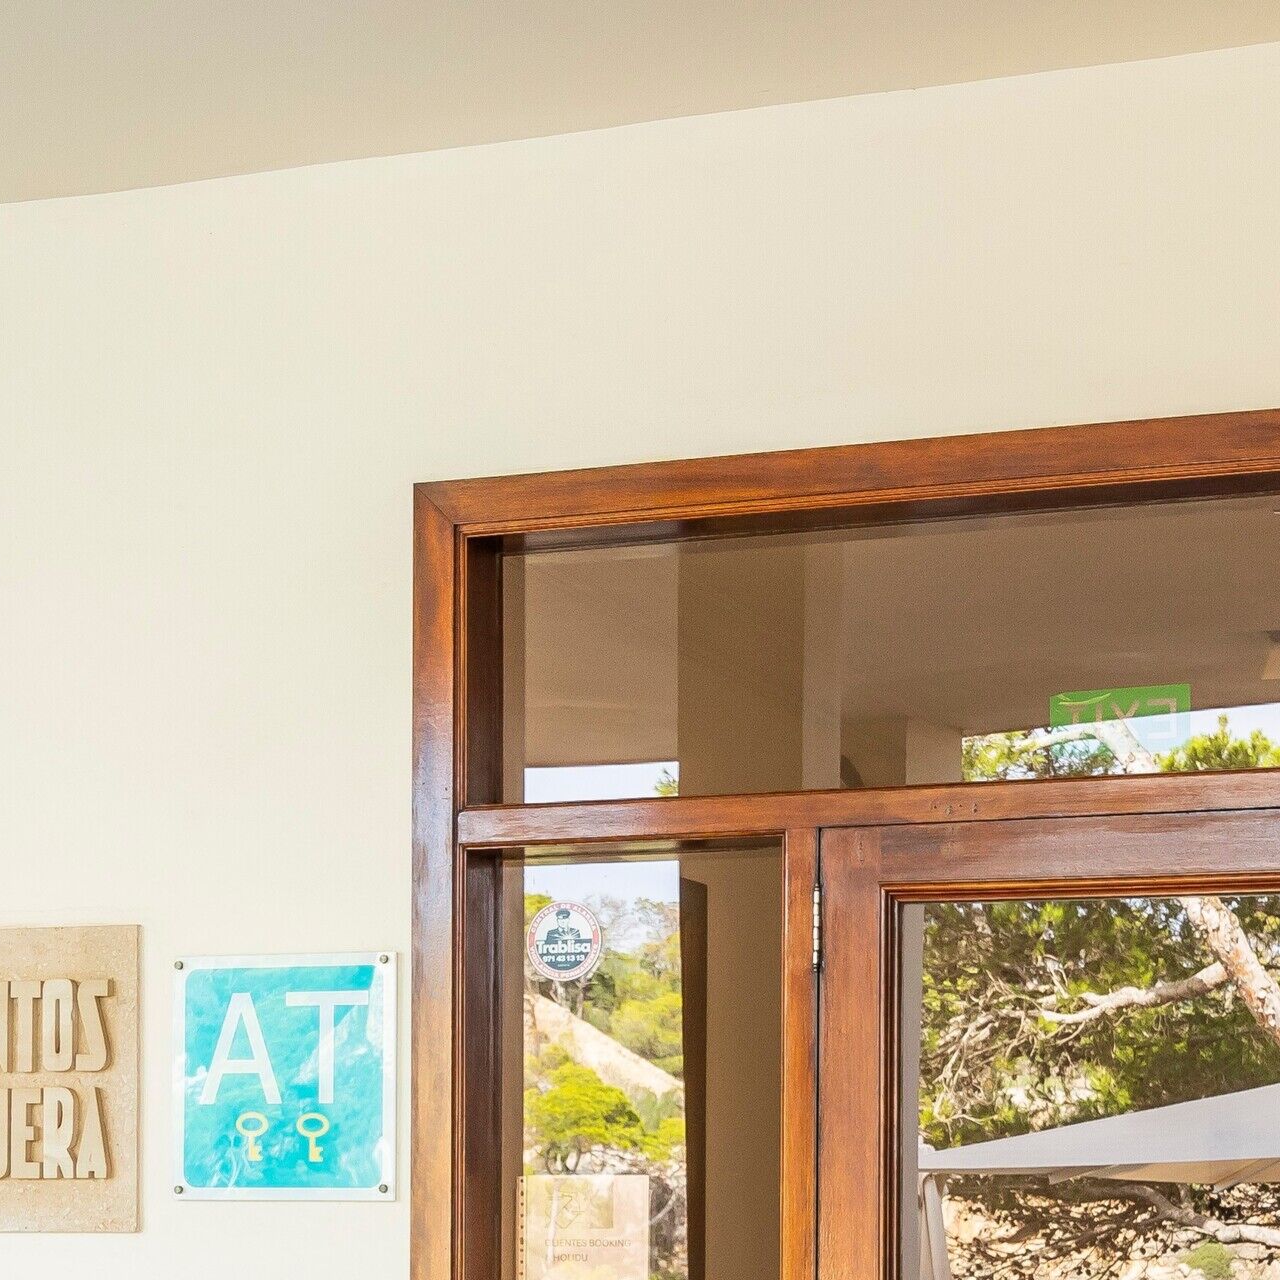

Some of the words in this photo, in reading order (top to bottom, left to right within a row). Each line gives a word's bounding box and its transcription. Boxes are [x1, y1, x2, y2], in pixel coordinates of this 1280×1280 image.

[536, 940, 591, 954] Trablisa
[199, 989, 370, 1106] AT
[589, 1239, 632, 1247] BOOKING
